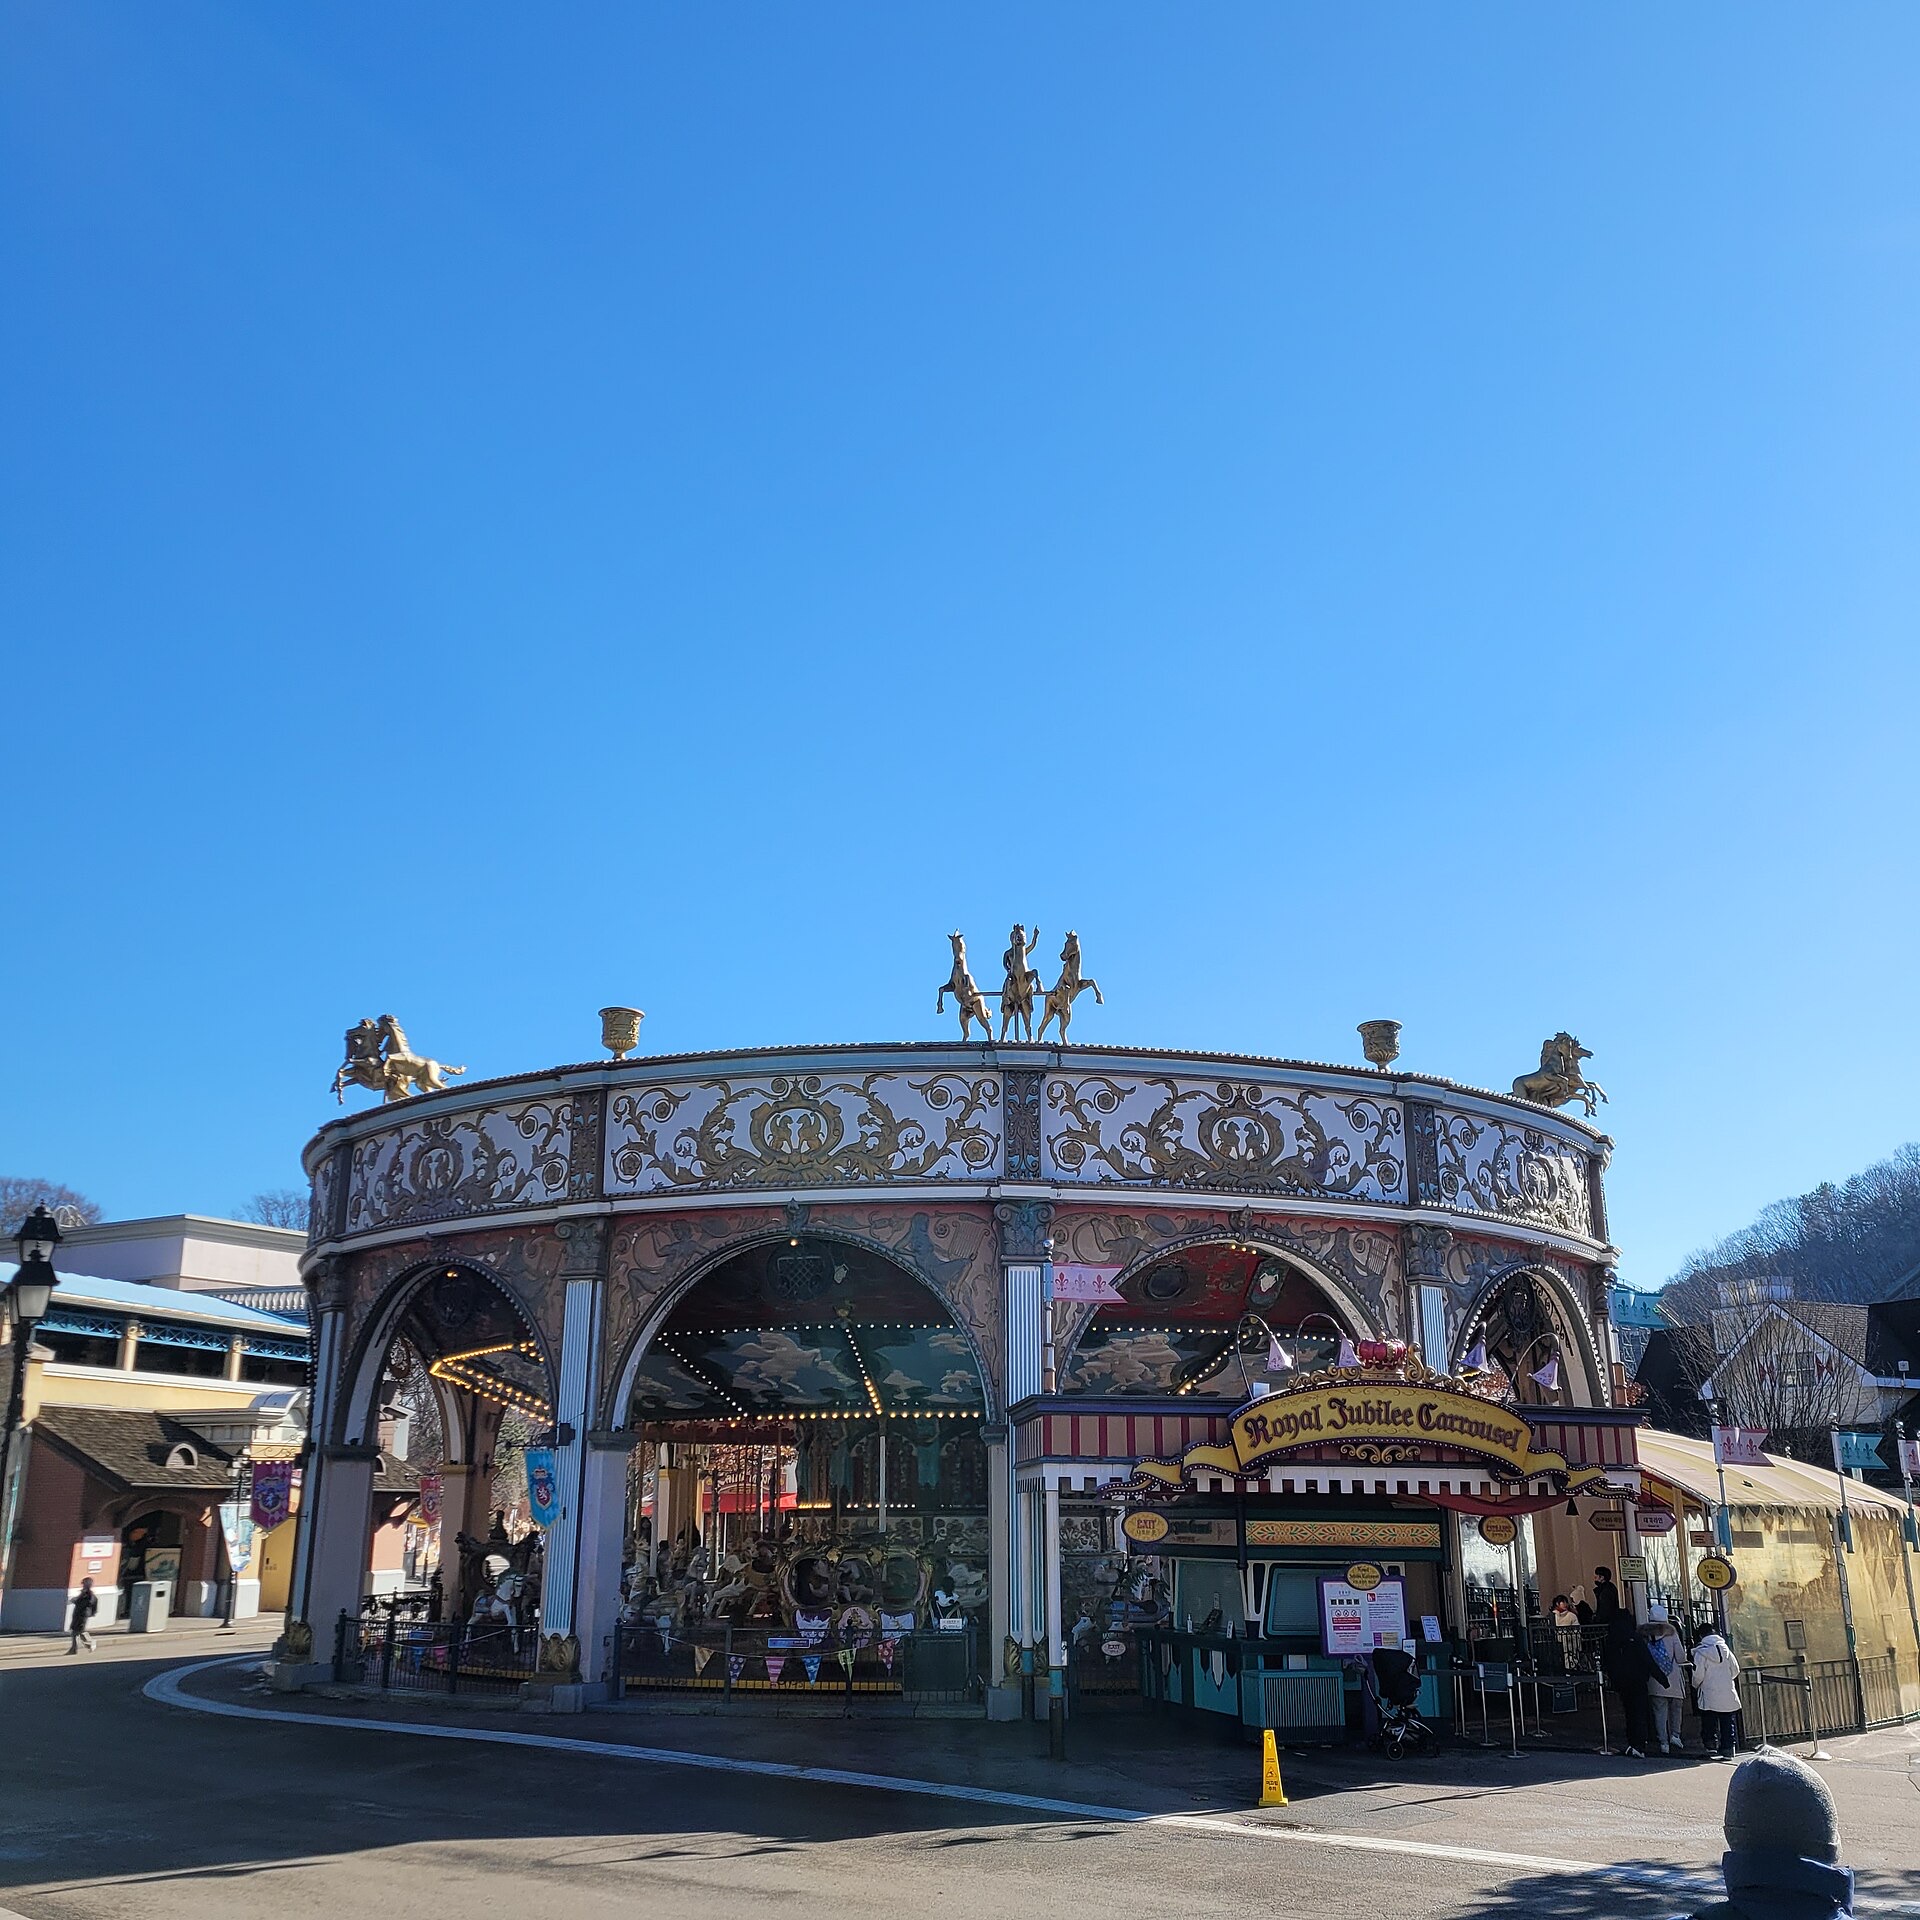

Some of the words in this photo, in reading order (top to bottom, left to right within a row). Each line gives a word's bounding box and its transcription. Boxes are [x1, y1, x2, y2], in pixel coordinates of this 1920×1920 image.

[1244, 1403, 1323, 1448] Royal
[1327, 1397, 1415, 1430] Jubilee
[1416, 1402, 1523, 1451] Carrousel
[1136, 1519, 1156, 1529] EXIT
